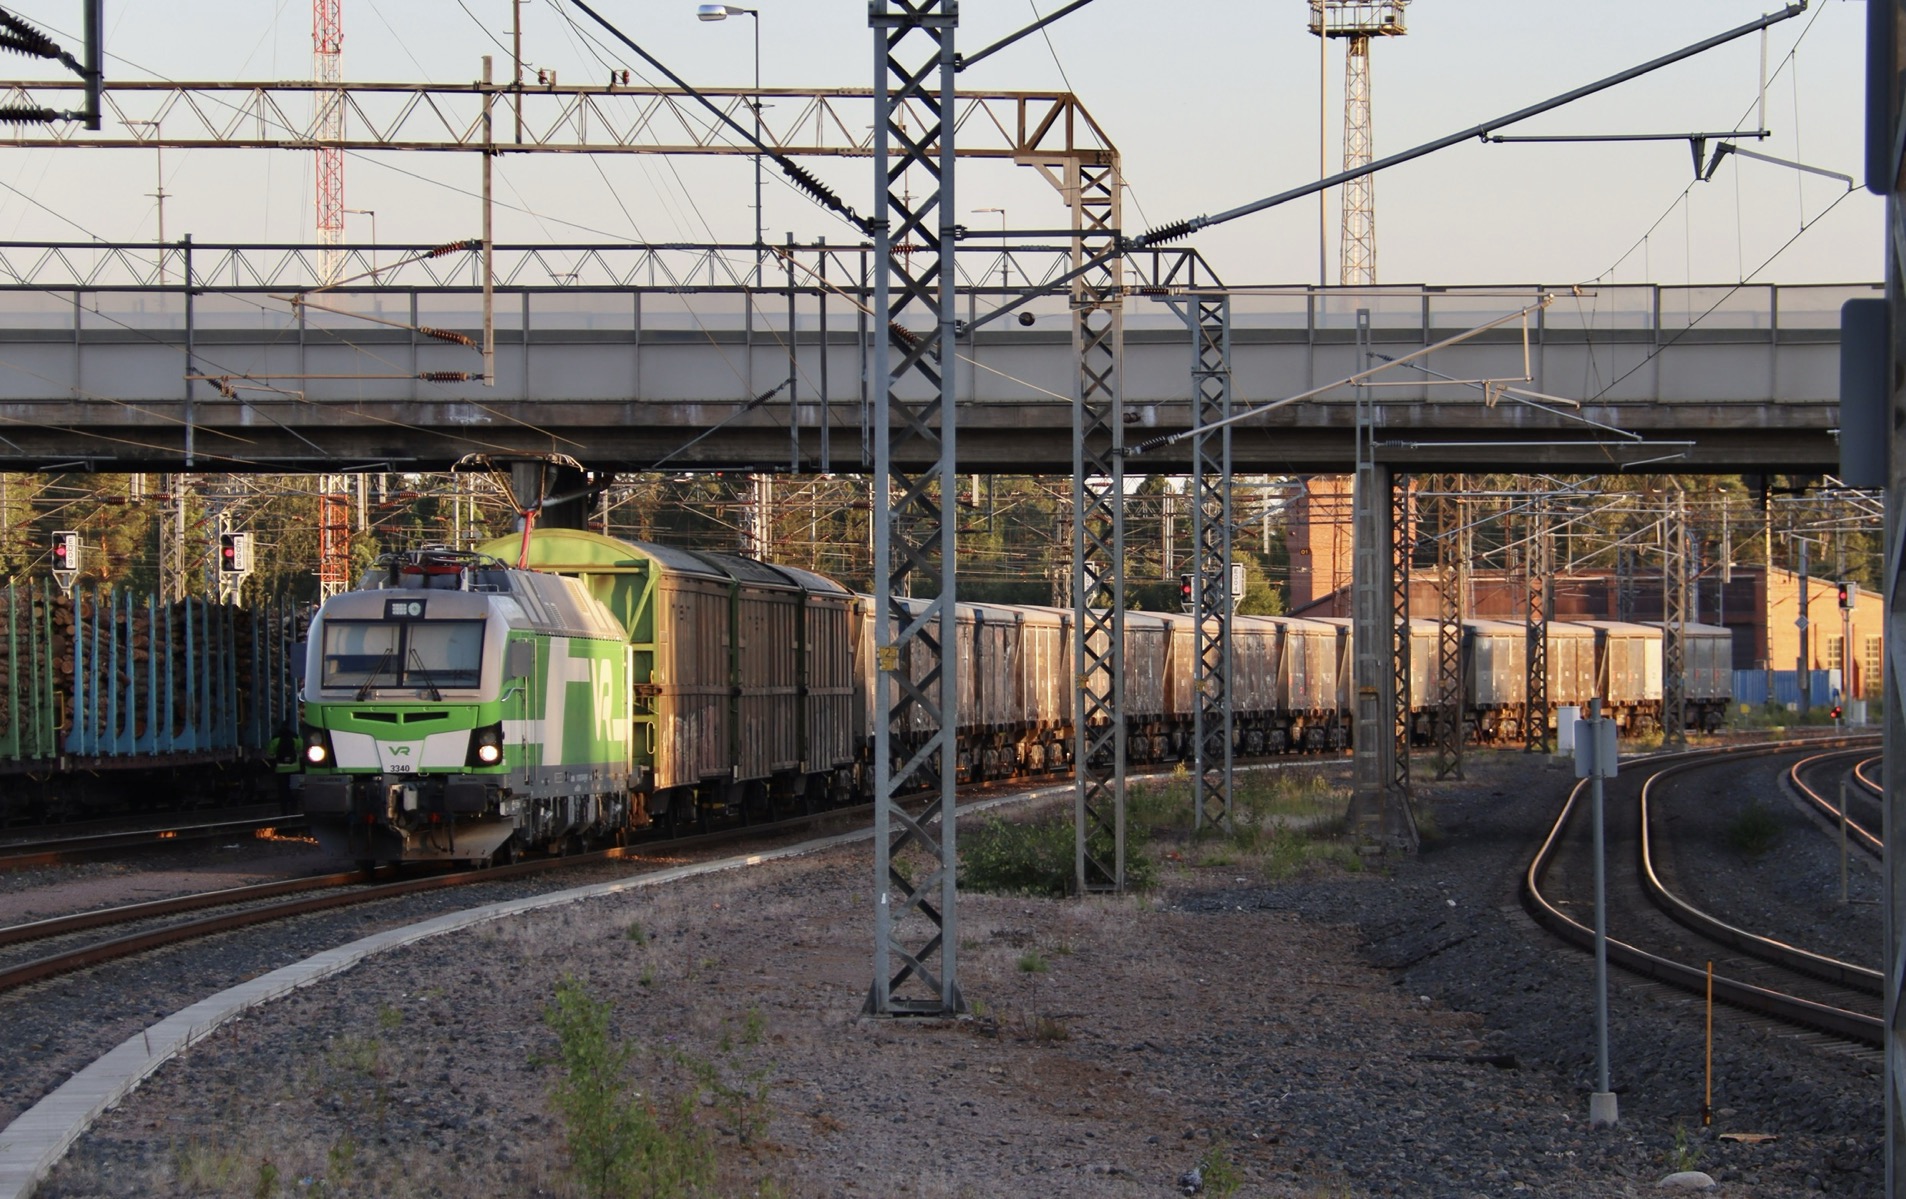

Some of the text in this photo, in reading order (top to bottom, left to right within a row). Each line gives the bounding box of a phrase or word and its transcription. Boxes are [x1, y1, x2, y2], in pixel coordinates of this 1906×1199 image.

[591, 658, 613, 742] VR
[388, 745, 410, 756] VR
[390, 765, 410, 773] 3340
